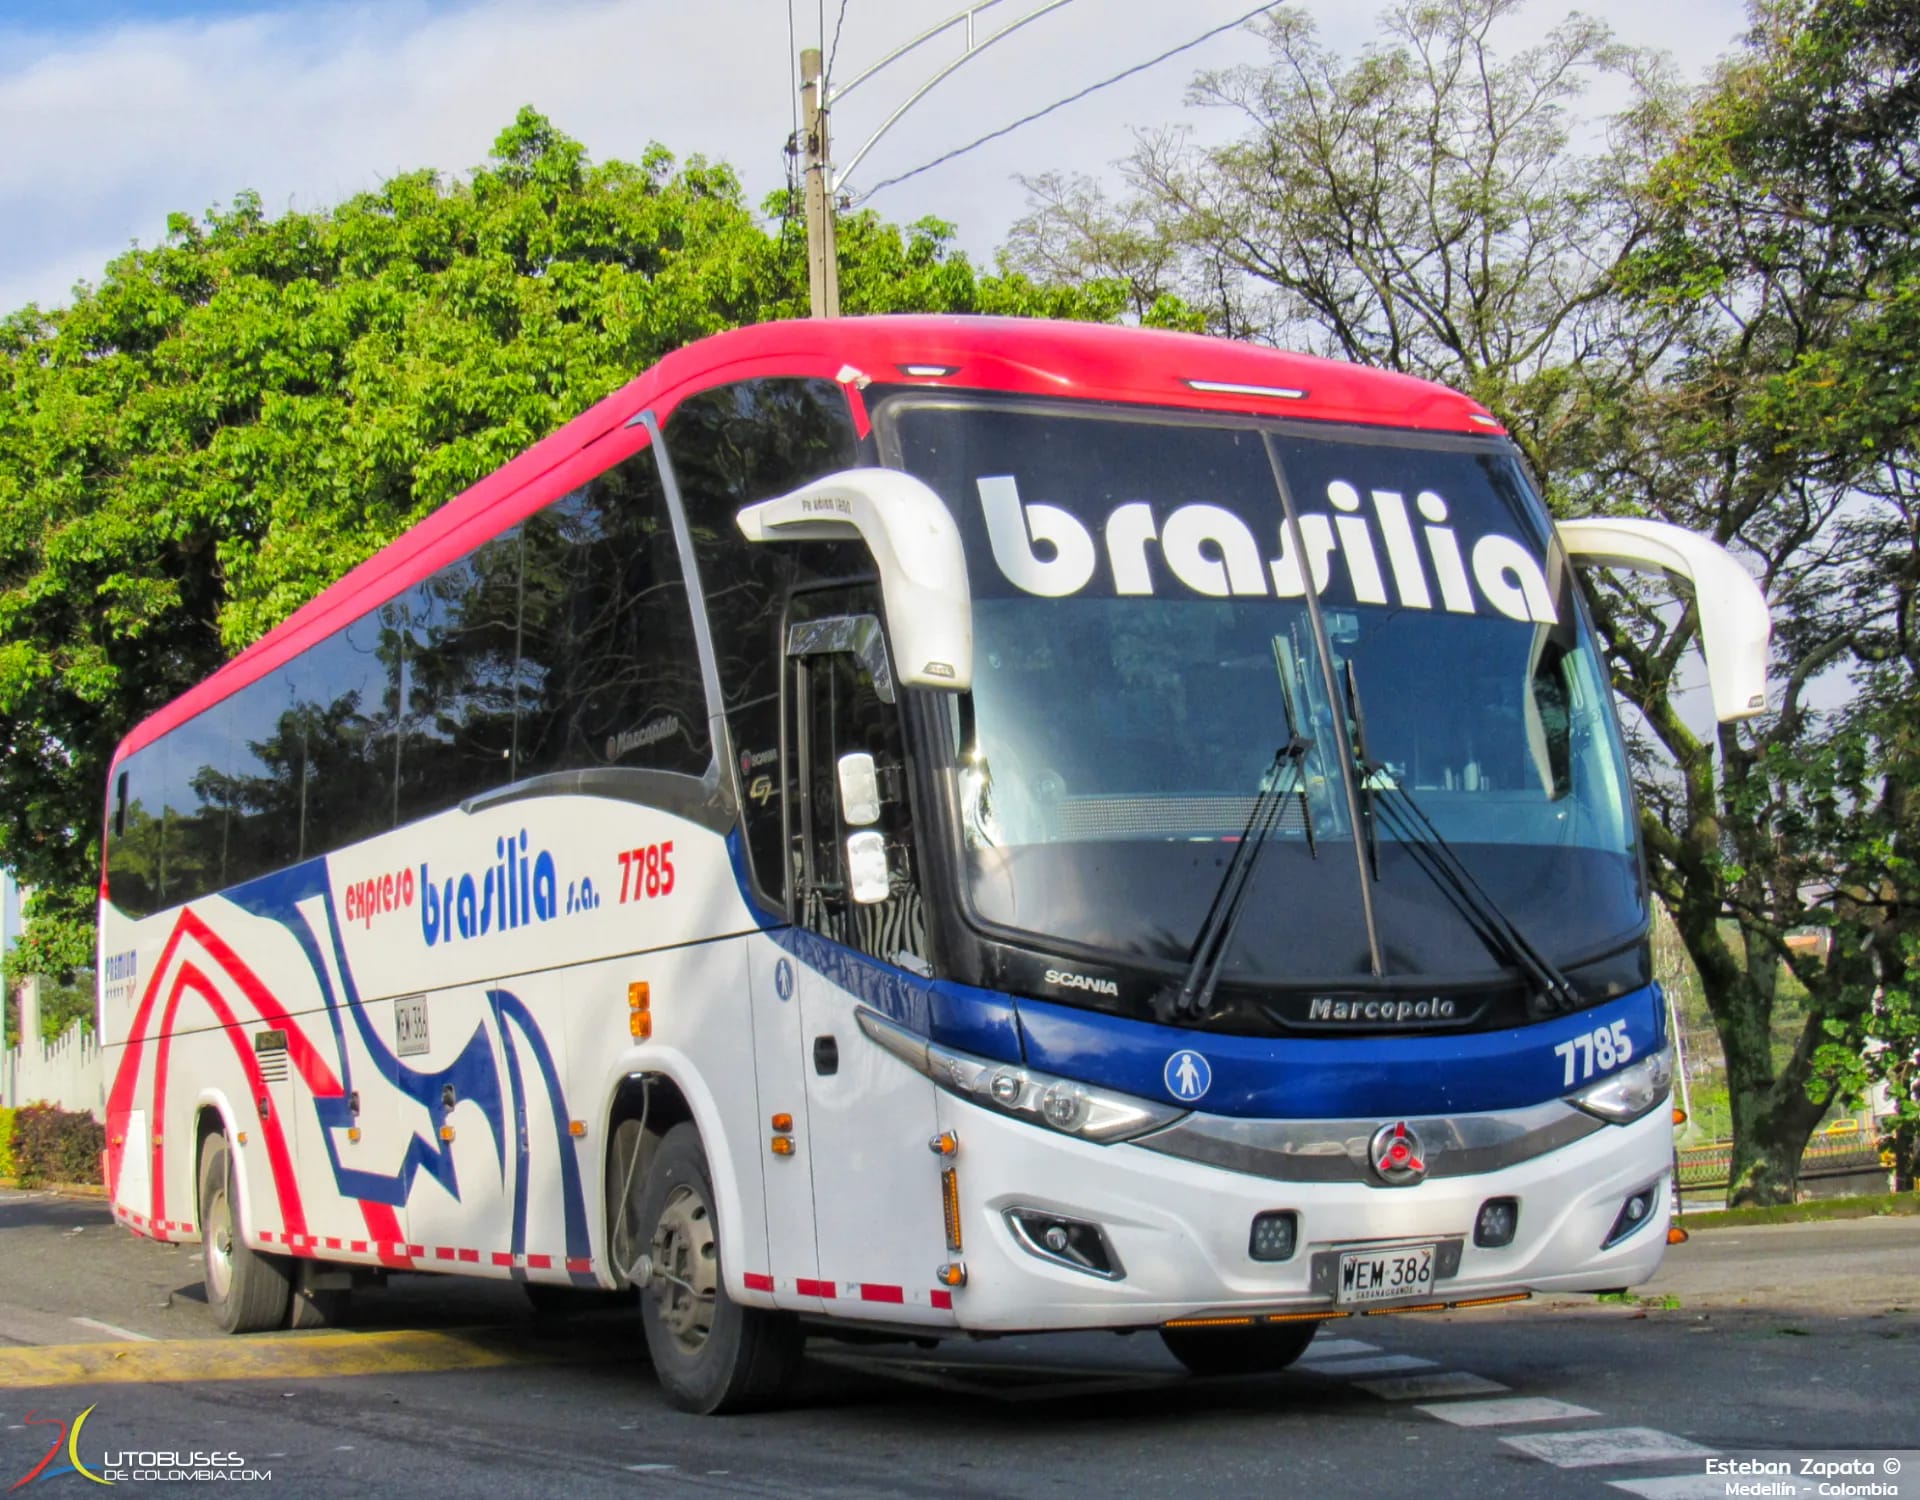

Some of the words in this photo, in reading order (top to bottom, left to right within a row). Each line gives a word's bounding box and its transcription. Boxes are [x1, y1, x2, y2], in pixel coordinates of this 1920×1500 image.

[976, 475, 1558, 624] brasilia
[617, 716, 678, 754] Marcopolo
[346, 867, 414, 929] expreso
[420, 828, 557, 946] brasilia
[618, 840, 675, 904] 7785
[1045, 969, 1118, 997] SCANIA
[1308, 997, 1455, 1022] Marcopolo
[1554, 1018, 1633, 1086] 7785
[1344, 1260, 1384, 1291] WEM
[1391, 1253, 1431, 1285] 386
